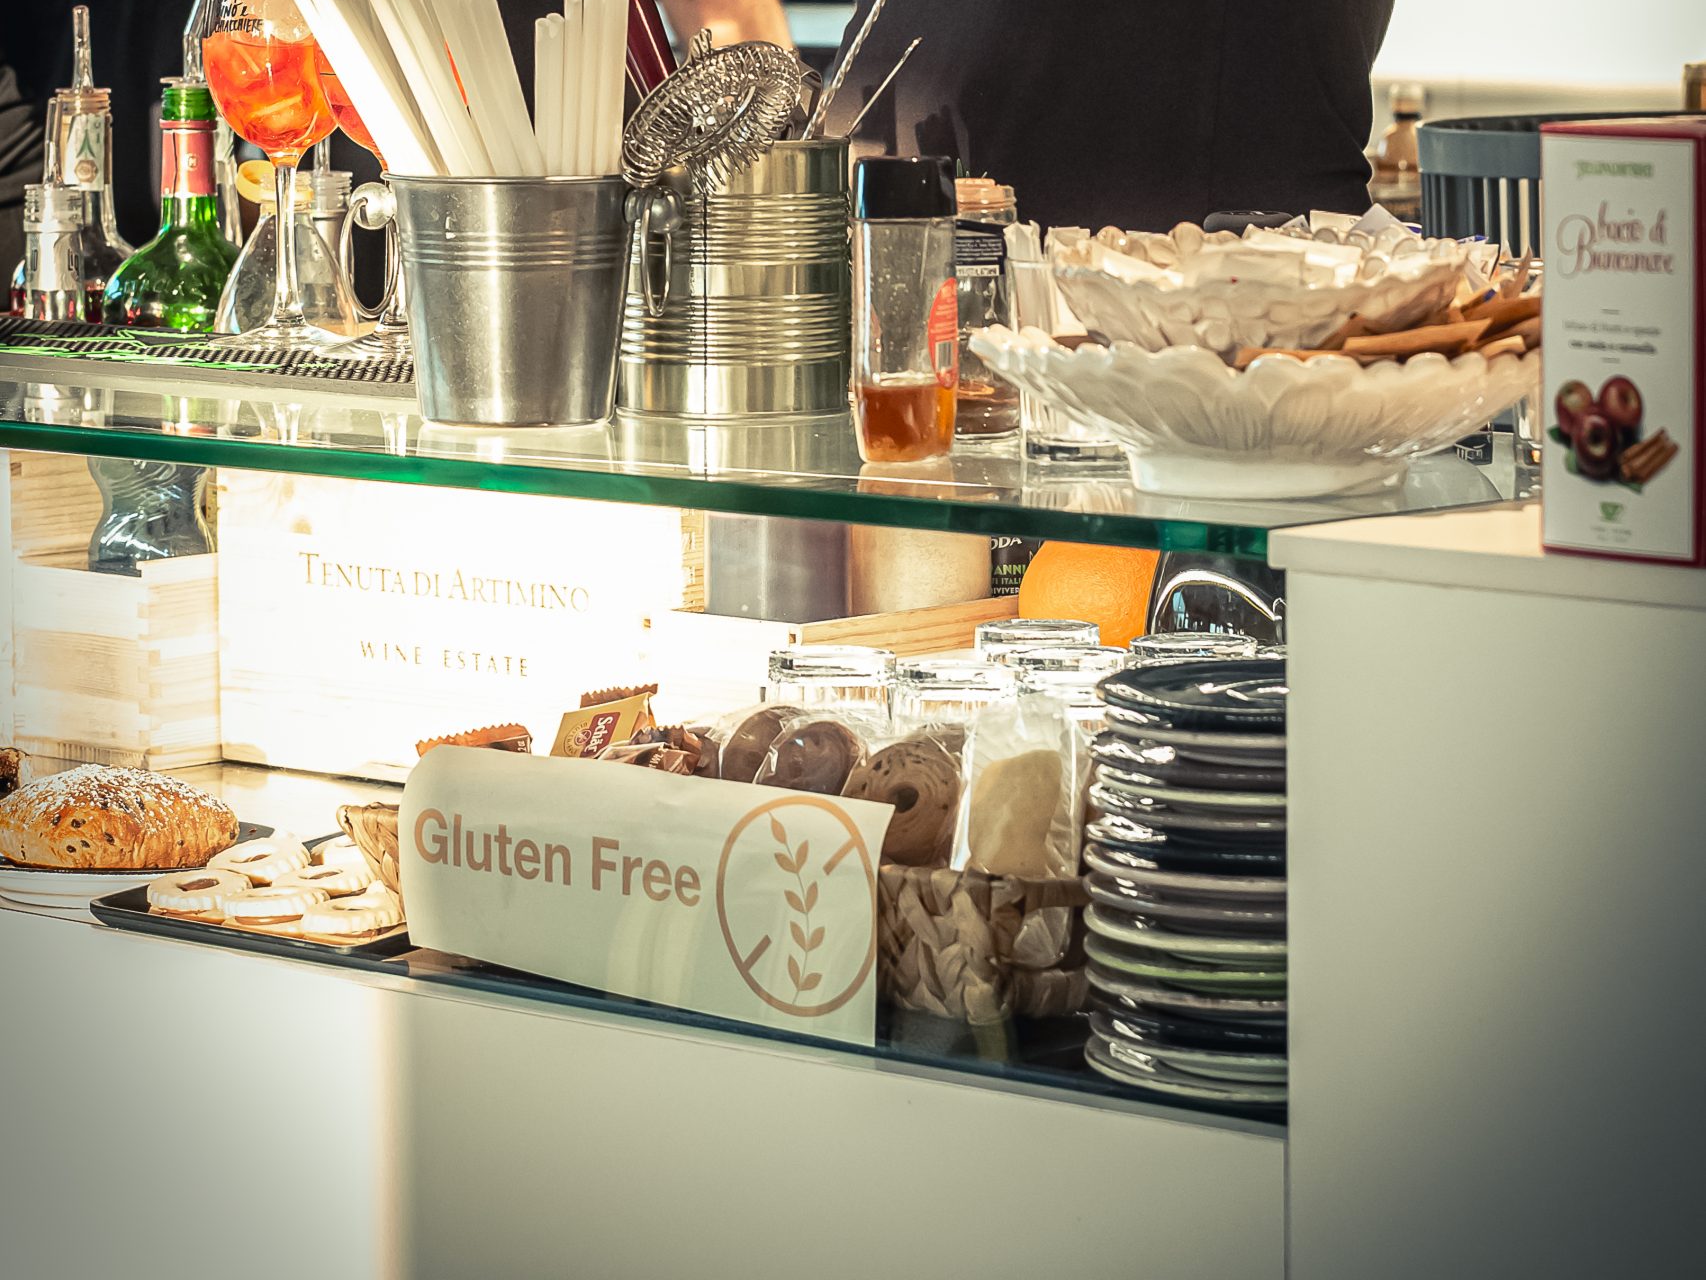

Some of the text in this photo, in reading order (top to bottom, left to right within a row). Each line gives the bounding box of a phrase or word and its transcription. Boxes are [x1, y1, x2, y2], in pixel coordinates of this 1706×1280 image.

[414, 571, 440, 598] DI
[360, 640, 528, 677] WINE ESTATE
[585, 716, 613, 753] Schär
[413, 808, 701, 907] Gluten Free
